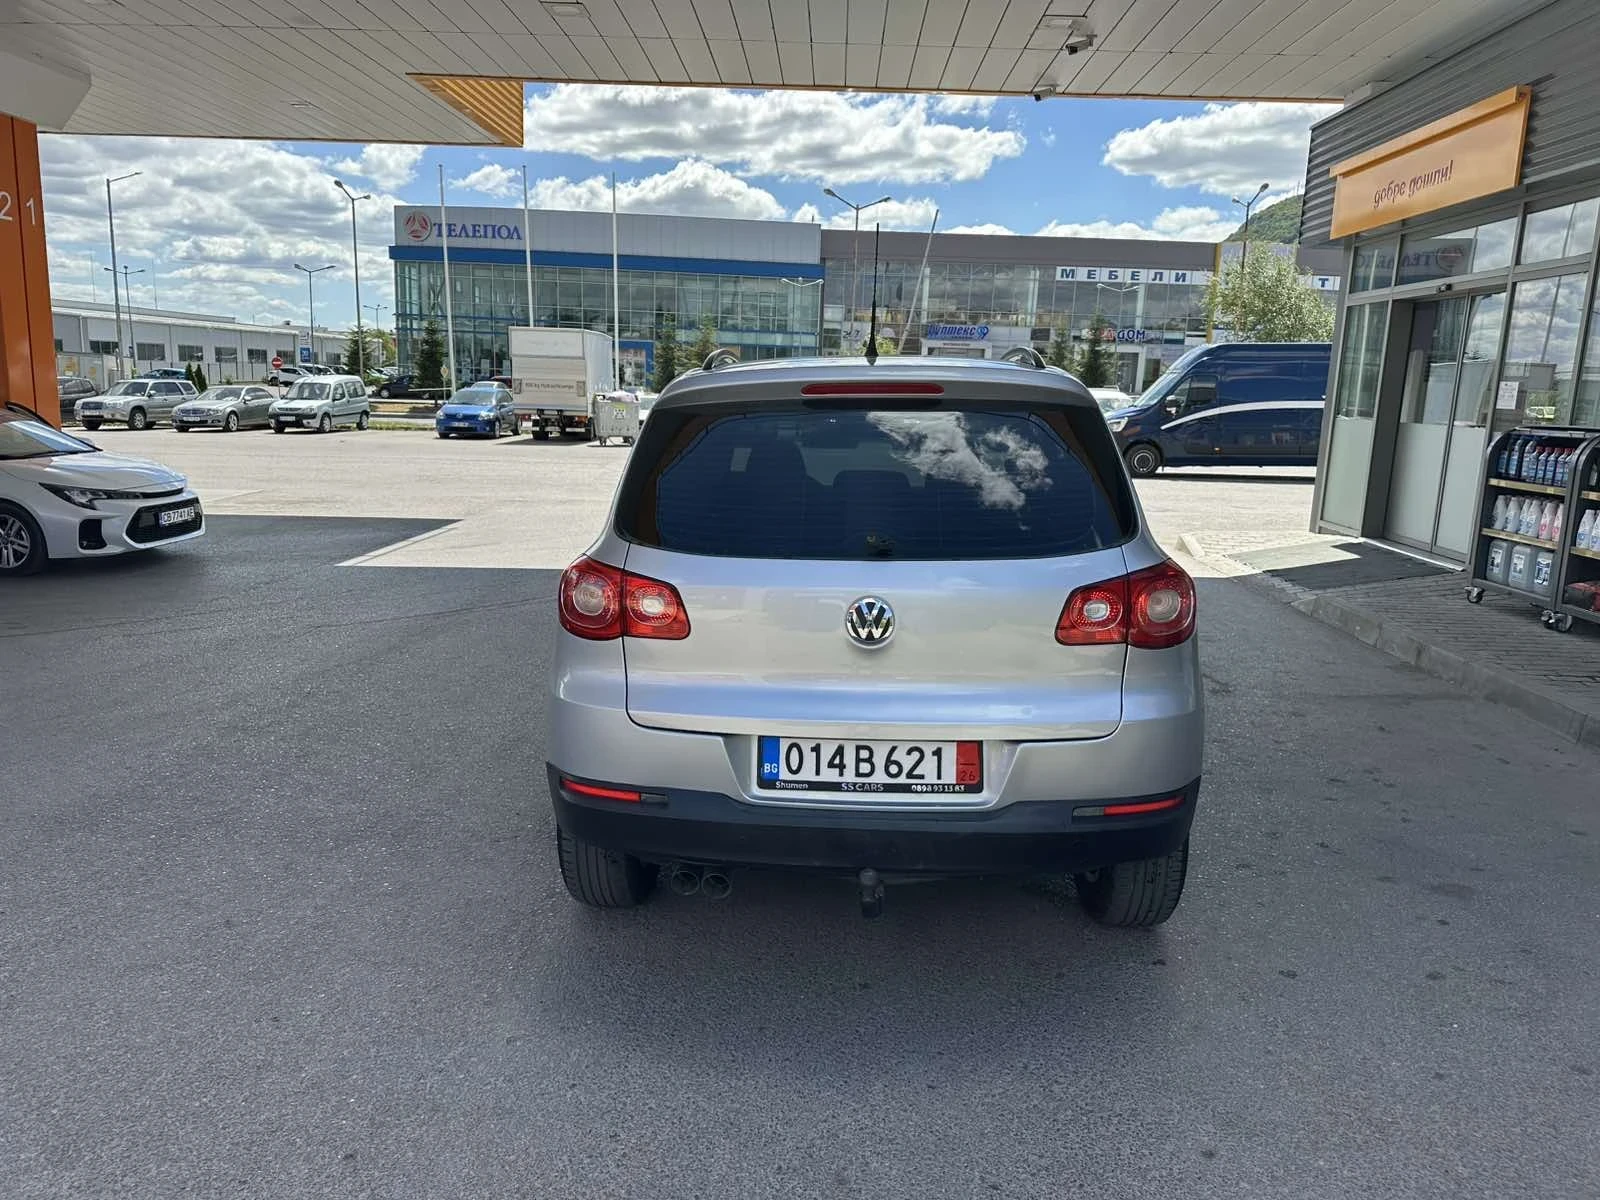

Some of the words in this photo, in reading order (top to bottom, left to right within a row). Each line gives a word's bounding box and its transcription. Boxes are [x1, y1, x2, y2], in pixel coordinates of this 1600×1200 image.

[1374, 180, 1406, 209] добре
[1408, 160, 1454, 198] дошли!
[0, 191, 13, 221] 2
[26, 198, 35, 225] 1
[433, 223, 522, 240] ТЕЛЕПОЛ
[1060, 268, 1187, 282] МЕБЕЛИ
[764, 763, 778, 773] BG
[960, 770, 976, 782] 26
[775, 781, 809, 790] Shumen
